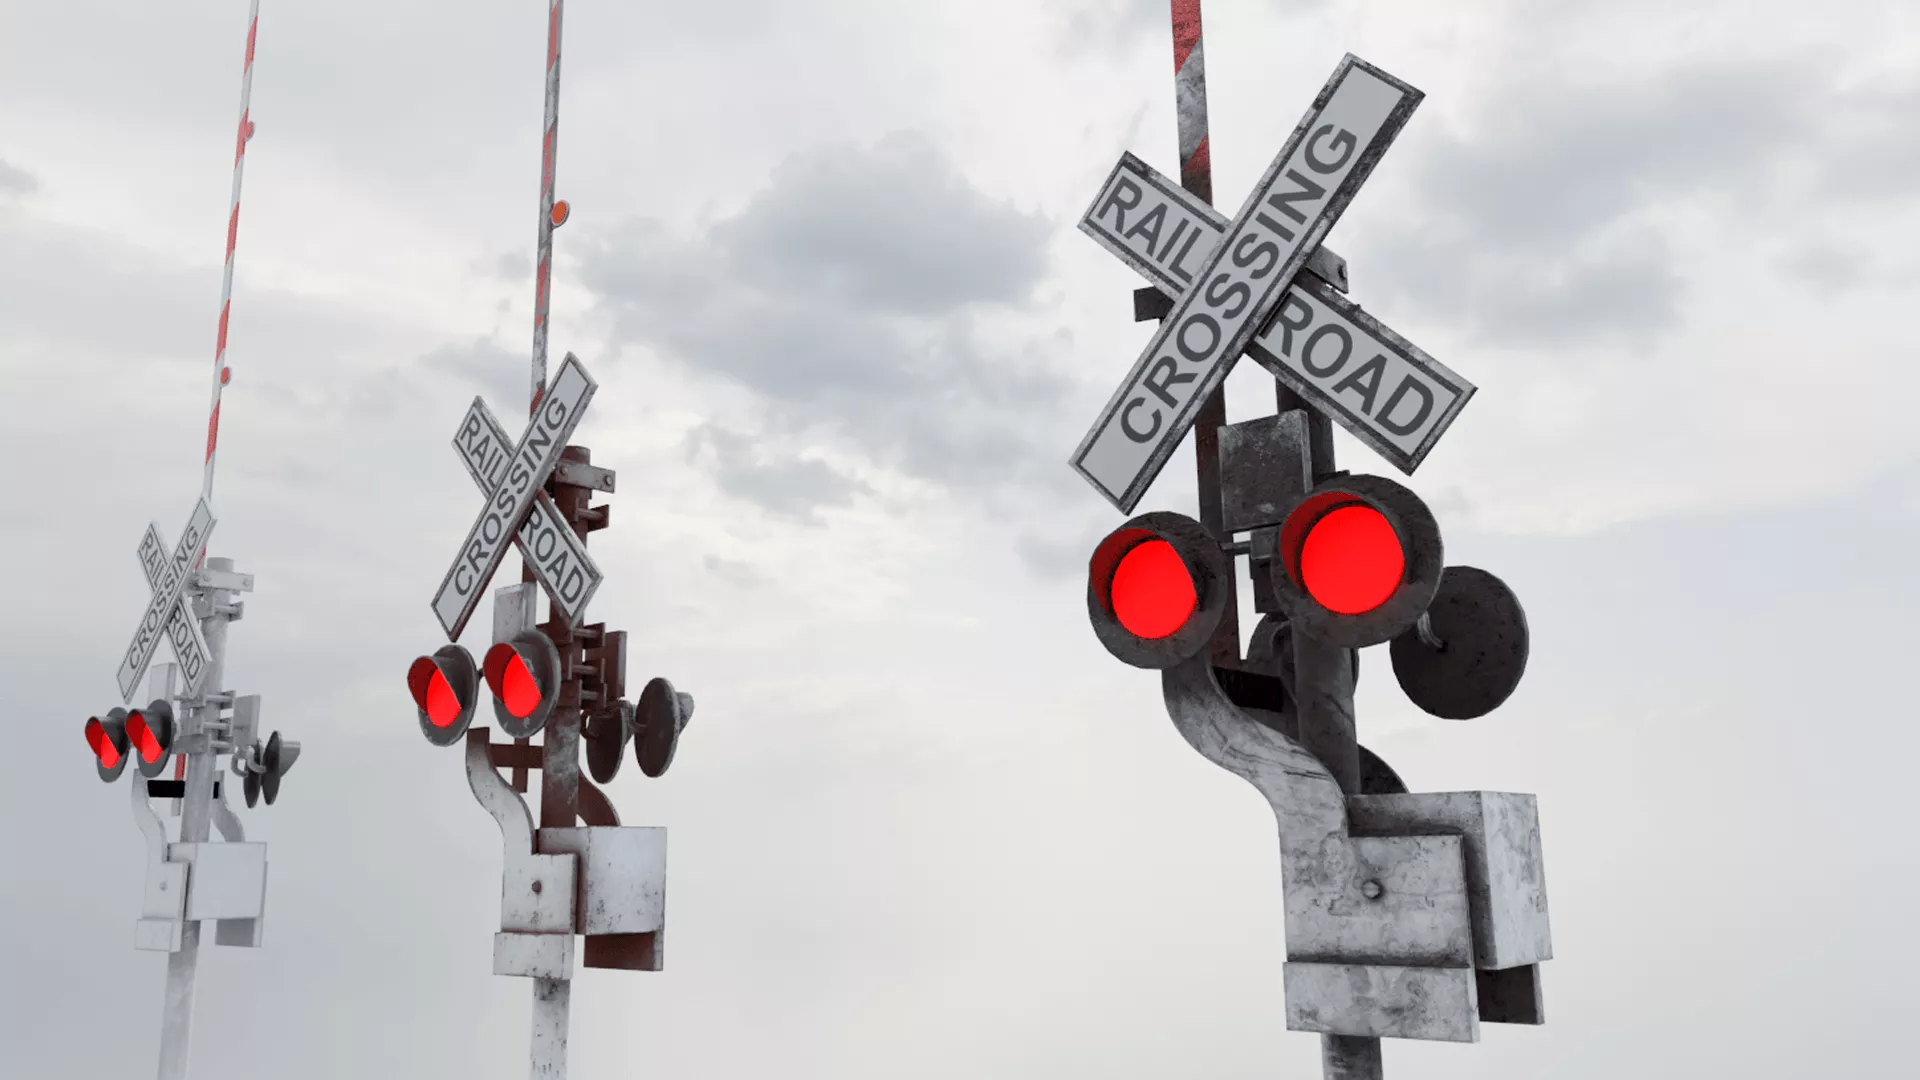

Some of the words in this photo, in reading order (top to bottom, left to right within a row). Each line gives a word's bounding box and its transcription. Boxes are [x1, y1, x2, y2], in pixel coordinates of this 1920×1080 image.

[1096, 175, 1203, 284] RAIL
[1260, 291, 1434, 437] ROAD
[1120, 123, 1357, 444] CROSSING
[454, 397, 567, 596] CROSSING
[460, 414, 504, 491] RAIL
[522, 505, 585, 604] ROAD
[129, 526, 198, 669] CROSSING
[141, 532, 164, 588] RAIL
[169, 604, 200, 680] ROAD
